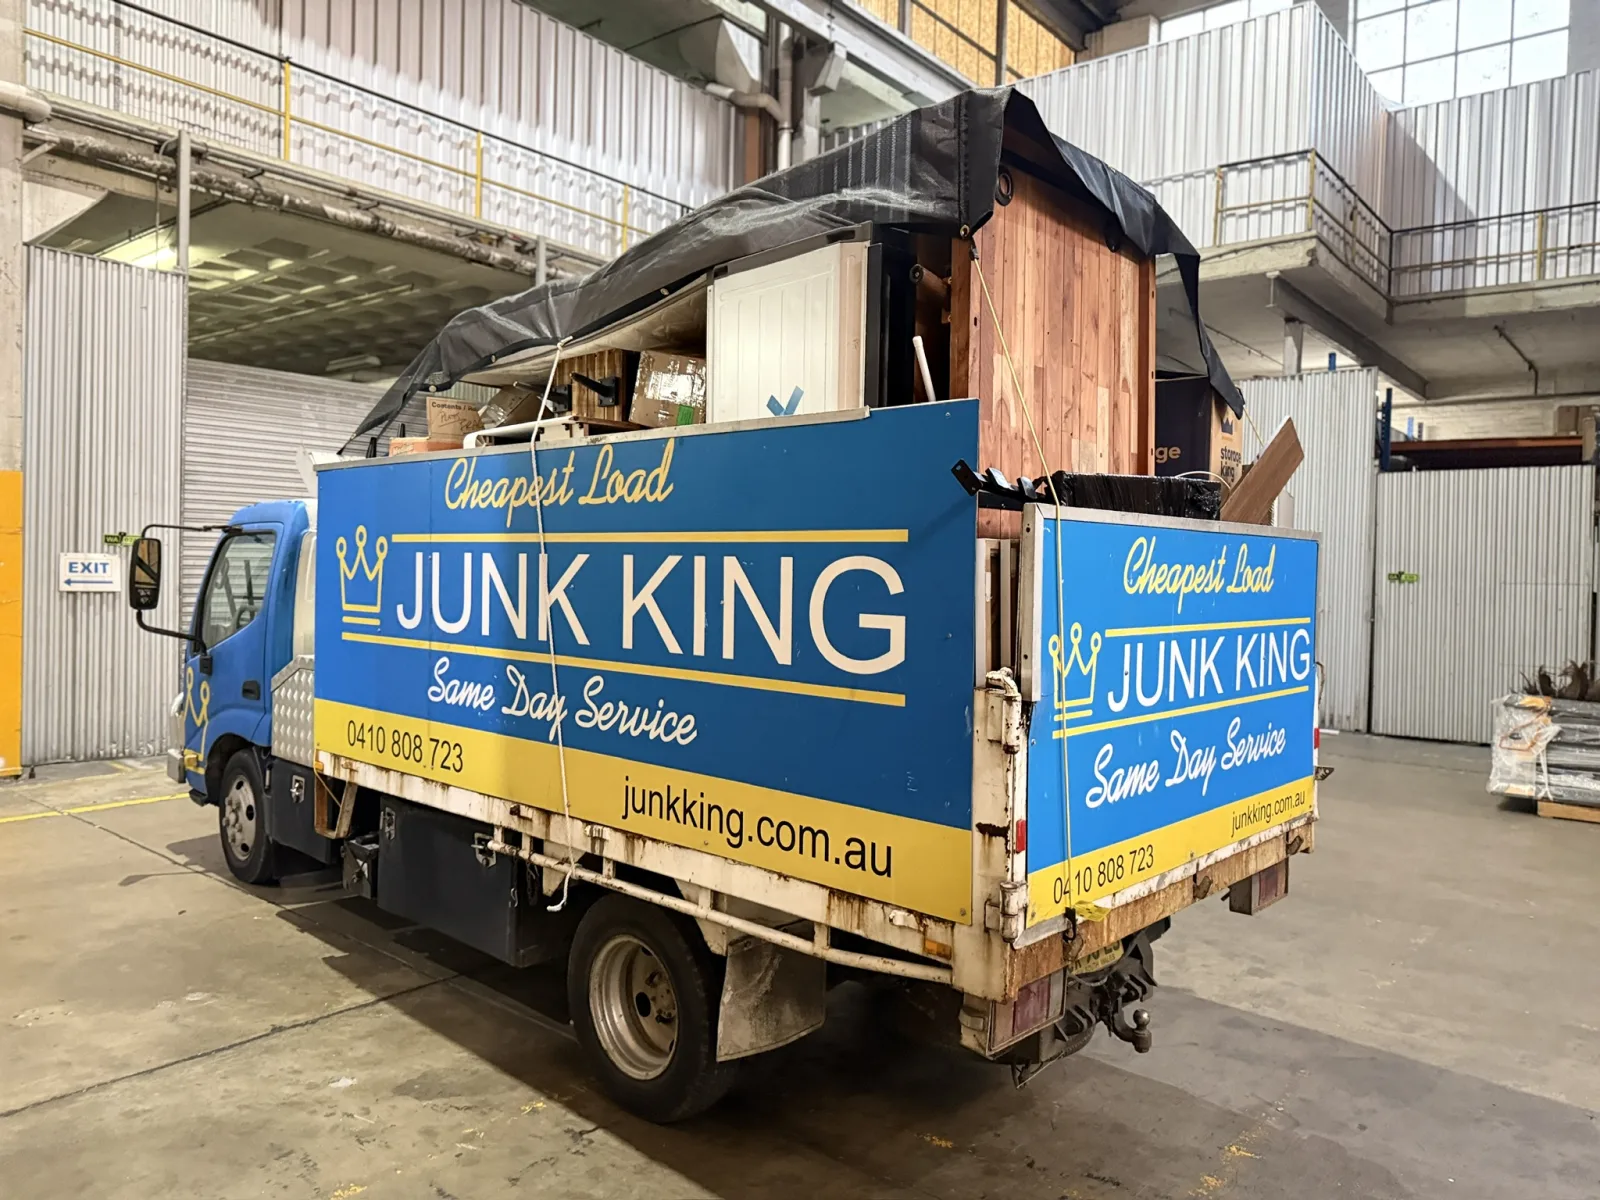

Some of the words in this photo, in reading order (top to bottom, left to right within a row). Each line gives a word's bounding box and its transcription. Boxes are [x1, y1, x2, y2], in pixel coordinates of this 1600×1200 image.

[445, 450, 575, 528] Cheapest
[578, 438, 674, 505] Load
[1220, 446, 1242, 467] storage
[1220, 460, 1235, 483] king
[68, 562, 109, 574] EXIT
[1123, 535, 1226, 614] Cheapest
[1227, 543, 1276, 593] Load
[397, 552, 590, 646] JUNK
[622, 554, 906, 675] KING
[427, 656, 496, 712] Same
[501, 664, 568, 742] Day
[574, 675, 698, 746] Service
[1107, 635, 1225, 712] JUNK
[1235, 628, 1311, 692] KING
[347, 719, 386, 754] 0410
[391, 729, 423, 763] 808
[429, 737, 464, 773] 723
[1085, 743, 1160, 809] Same
[1165, 729, 1216, 797] Day
[1221, 717, 1286, 770] Service
[622, 775, 892, 878] junkking.com.au
[1231, 790, 1305, 838] junkking.com.au
[1053, 866, 1093, 905] 0410
[1097, 854, 1125, 888] 808
[1129, 844, 1154, 876] 723
